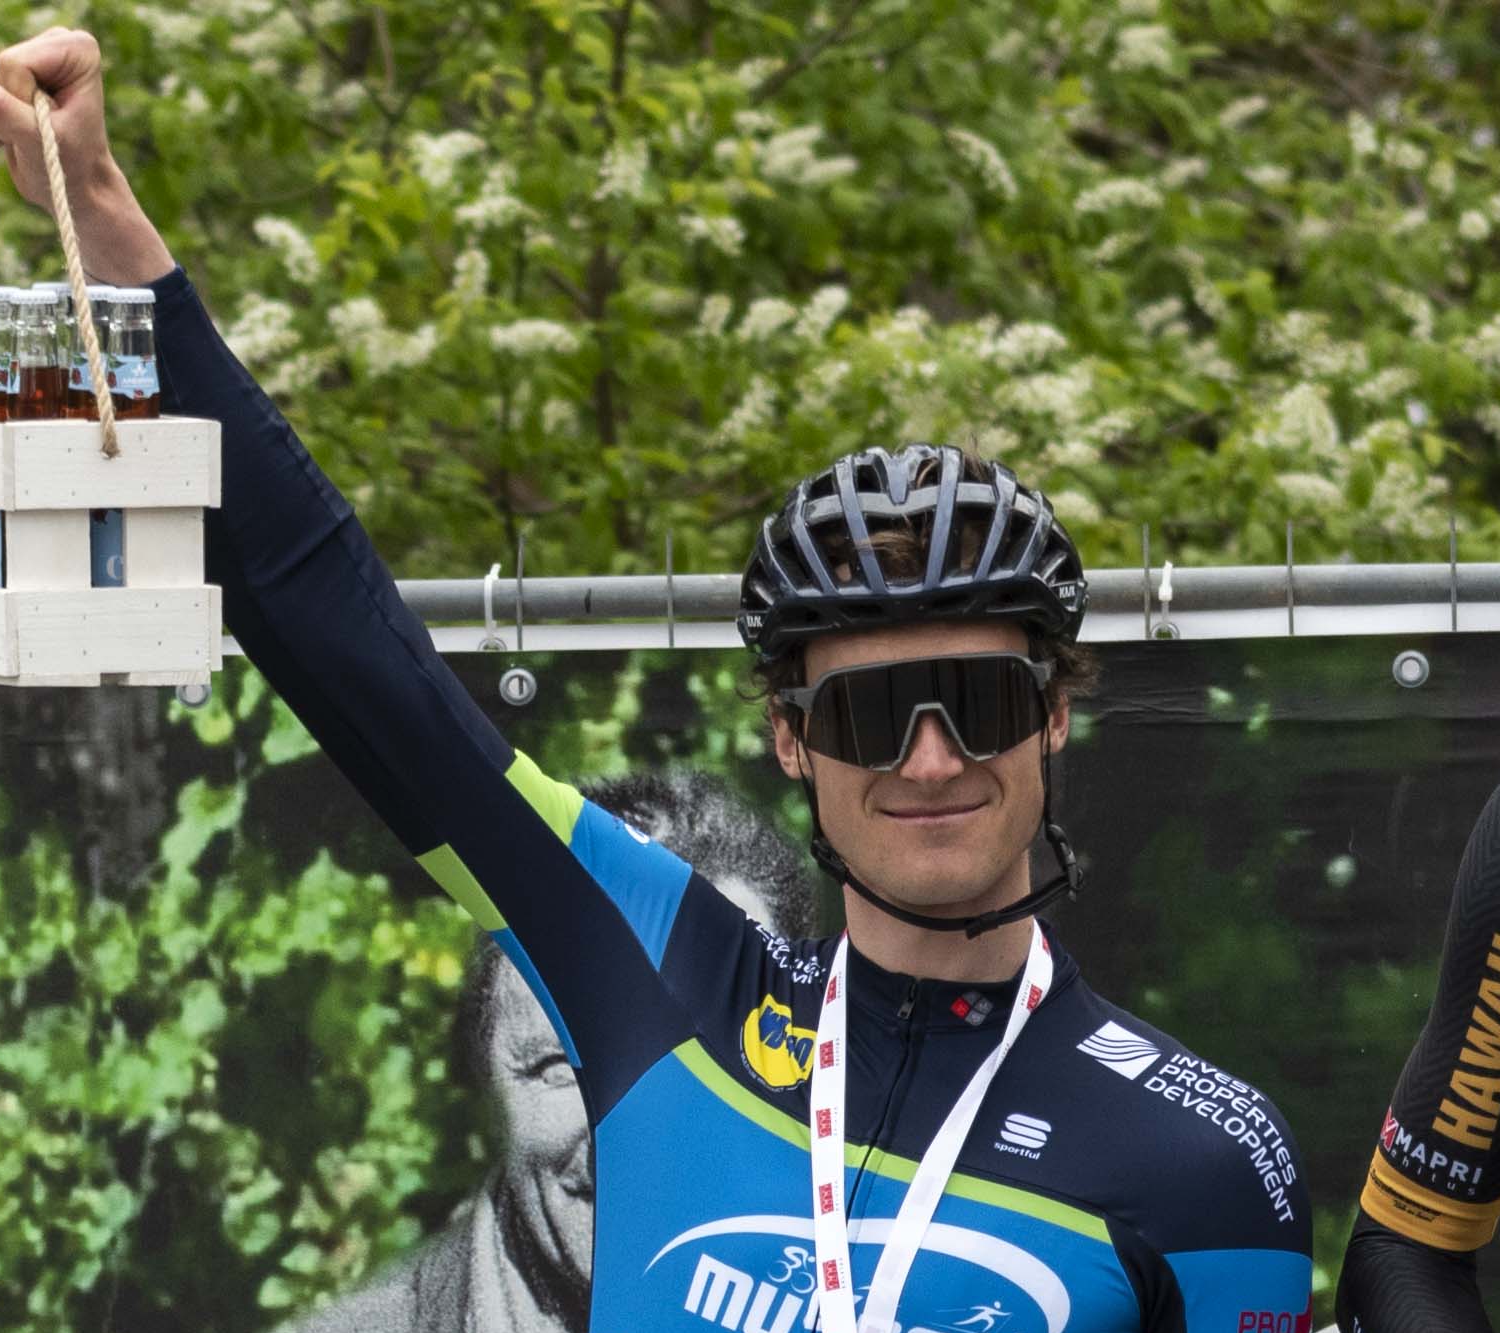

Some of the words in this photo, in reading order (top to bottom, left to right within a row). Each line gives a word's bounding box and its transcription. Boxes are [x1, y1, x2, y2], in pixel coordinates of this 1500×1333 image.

[1169, 1051, 1268, 1104] INVEST
[993, 1140, 1041, 1161] sportful
[1143, 1075, 1295, 1224] DEVELOPMENT
[1158, 1063, 1298, 1187] PROPERTIES
[1395, 1125, 1484, 1186] MAPRI
